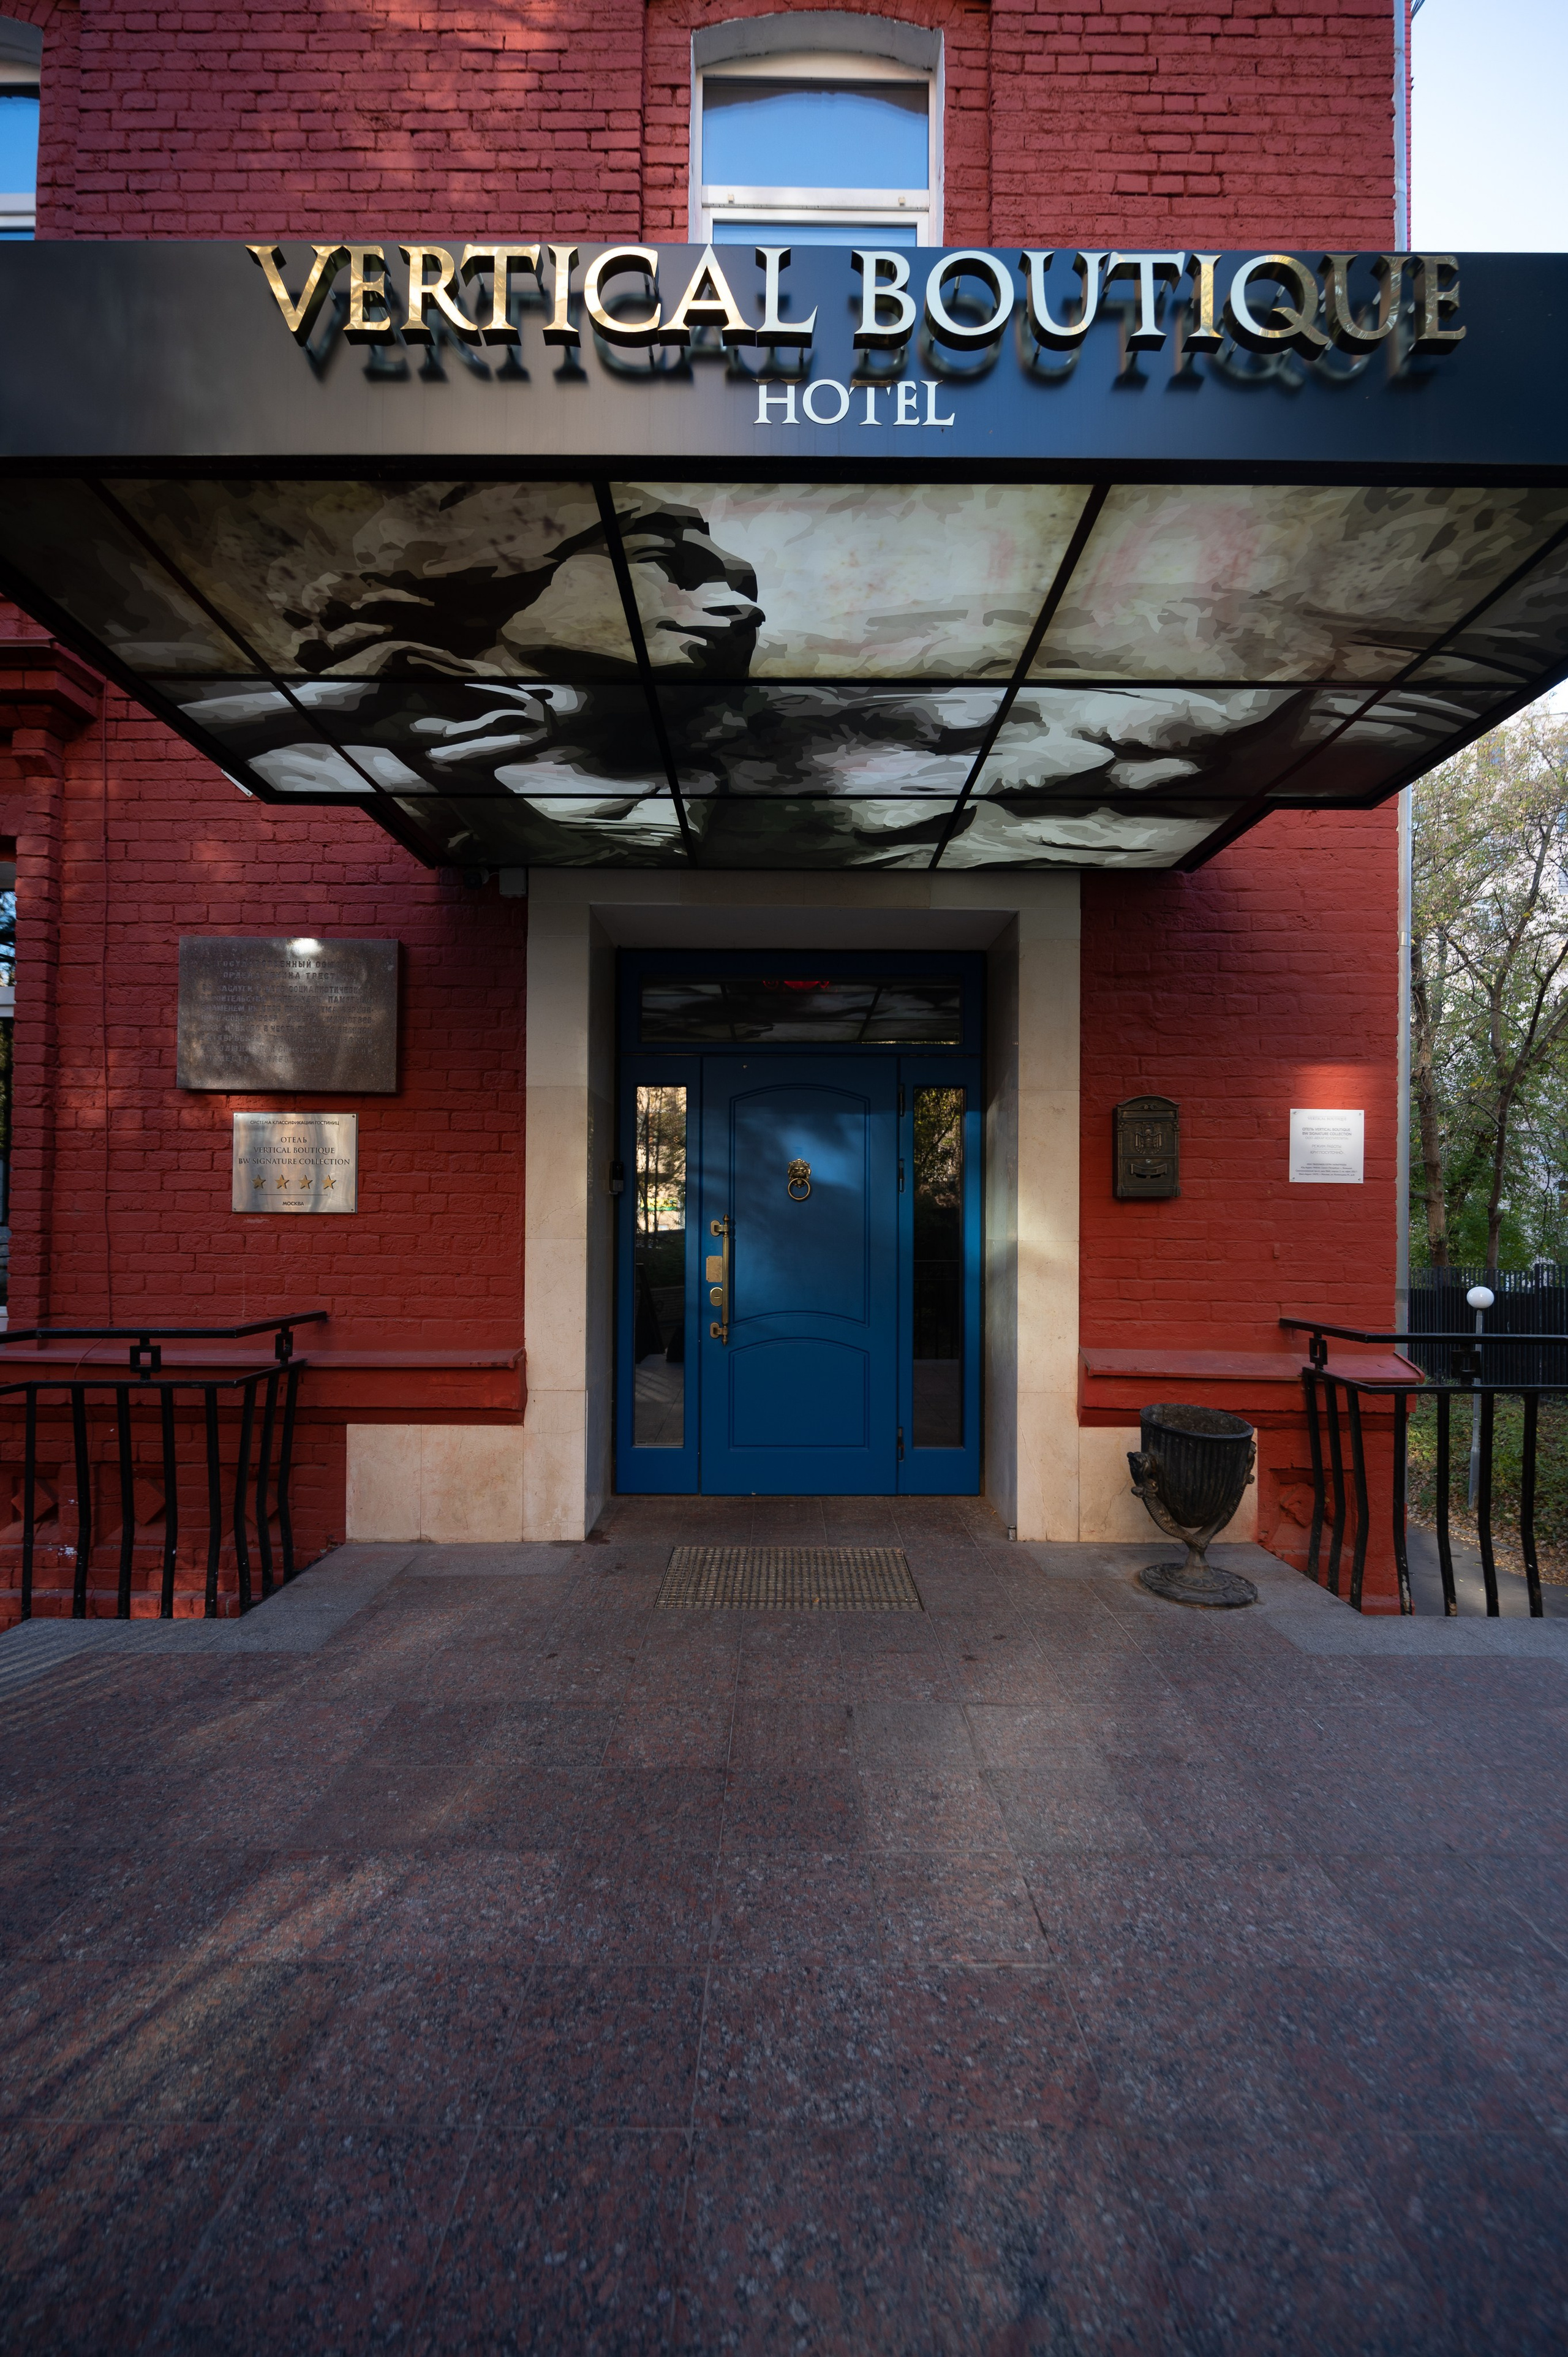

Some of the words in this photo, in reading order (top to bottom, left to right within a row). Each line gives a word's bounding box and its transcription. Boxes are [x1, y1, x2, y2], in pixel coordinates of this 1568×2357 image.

[246, 244, 818, 347] VERTICAL
[851, 251, 1467, 360] BOUTIQUE
[753, 379, 956, 427] HOTEL
